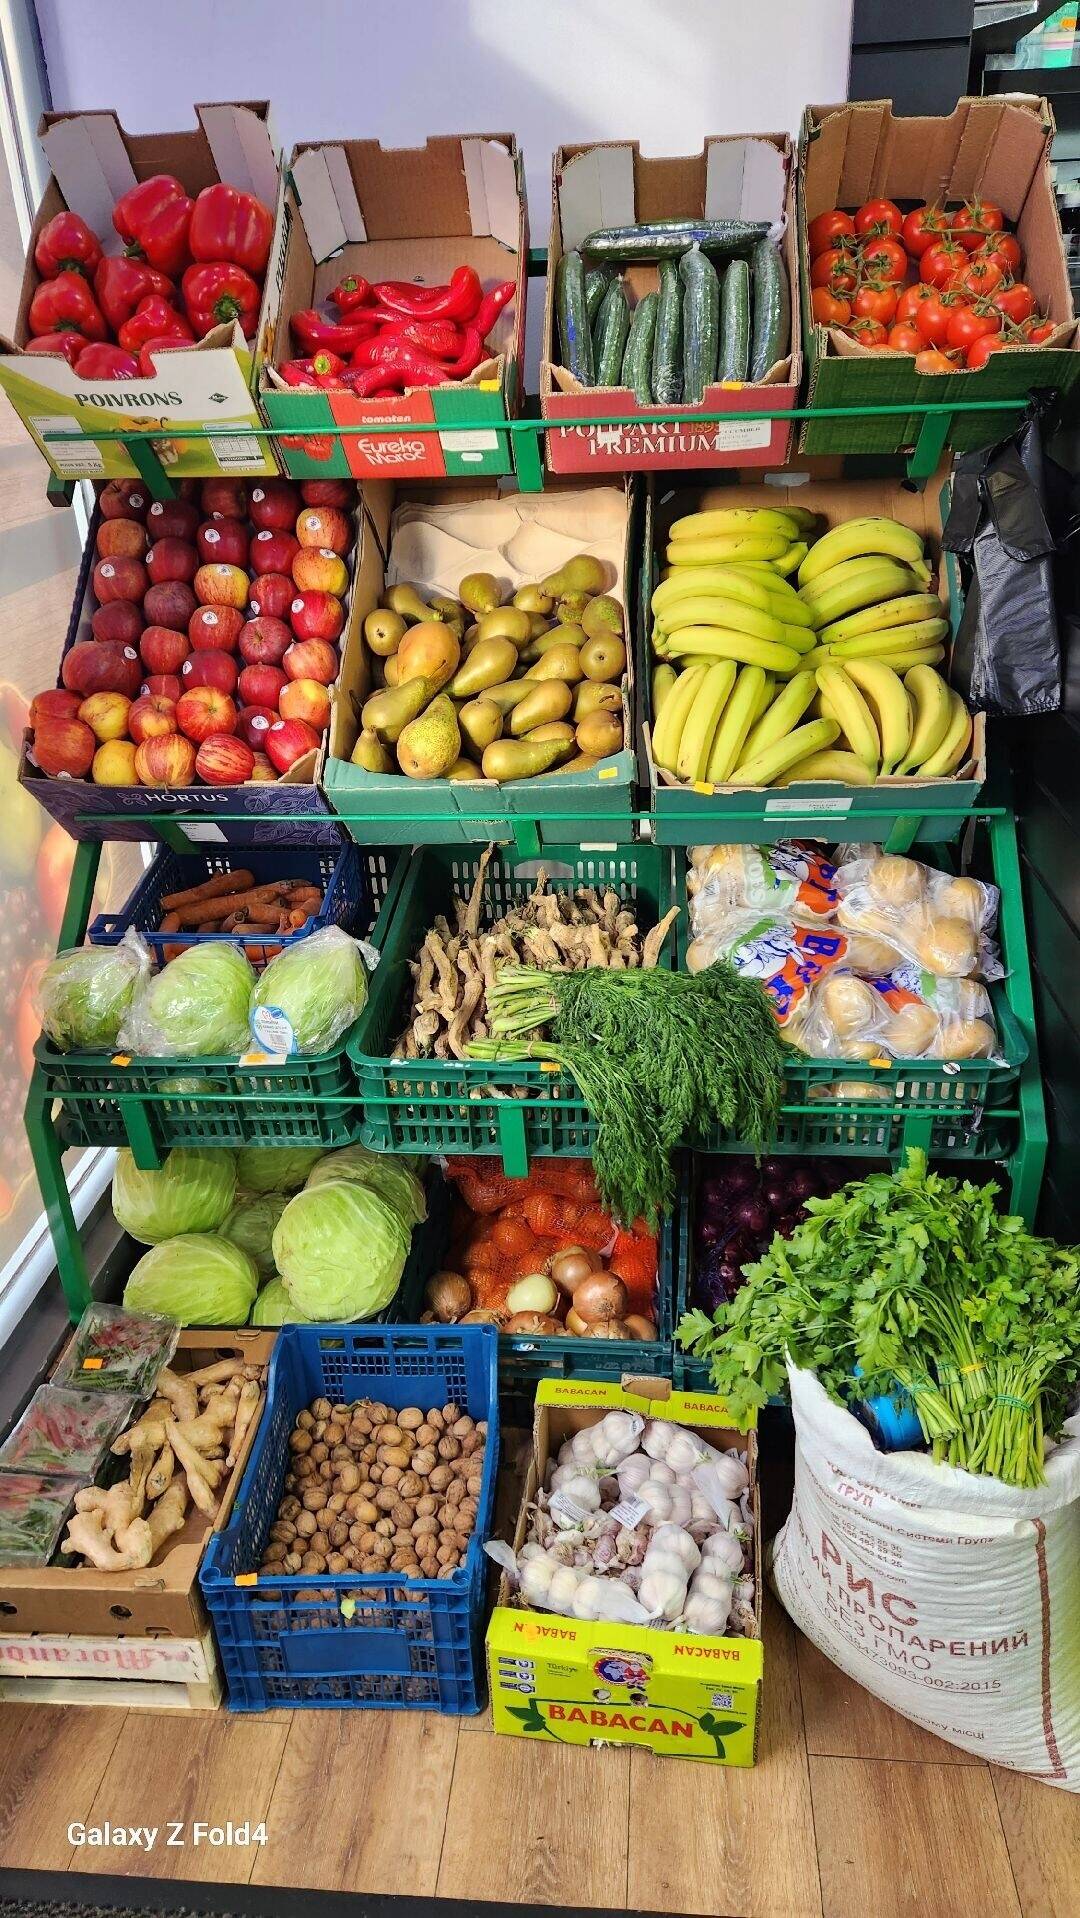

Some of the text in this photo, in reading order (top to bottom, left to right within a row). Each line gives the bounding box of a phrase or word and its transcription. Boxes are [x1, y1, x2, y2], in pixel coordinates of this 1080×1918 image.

[74, 391, 183, 407] POIVRONS
[361, 414, 412, 424] tomaten
[357, 437, 425, 454] Eureka
[589, 434, 719, 456] PREMIUM
[365, 451, 426, 466] Maroc
[144, 793, 229, 802] HORTUS
[554, 1387, 607, 1397] BABACAN
[683, 1402, 730, 1414] BABACA
[837, 1482, 875, 1509] ГРУП
[821, 1529, 919, 1627] РИС
[839, 1585, 1029, 1657] ПРОПАРЕНИЙ
[826, 1591, 932, 1671] БЕЗ ГМО
[674, 1643, 741, 1662] BABACAN
[548, 1703, 694, 1739] BABACAN
